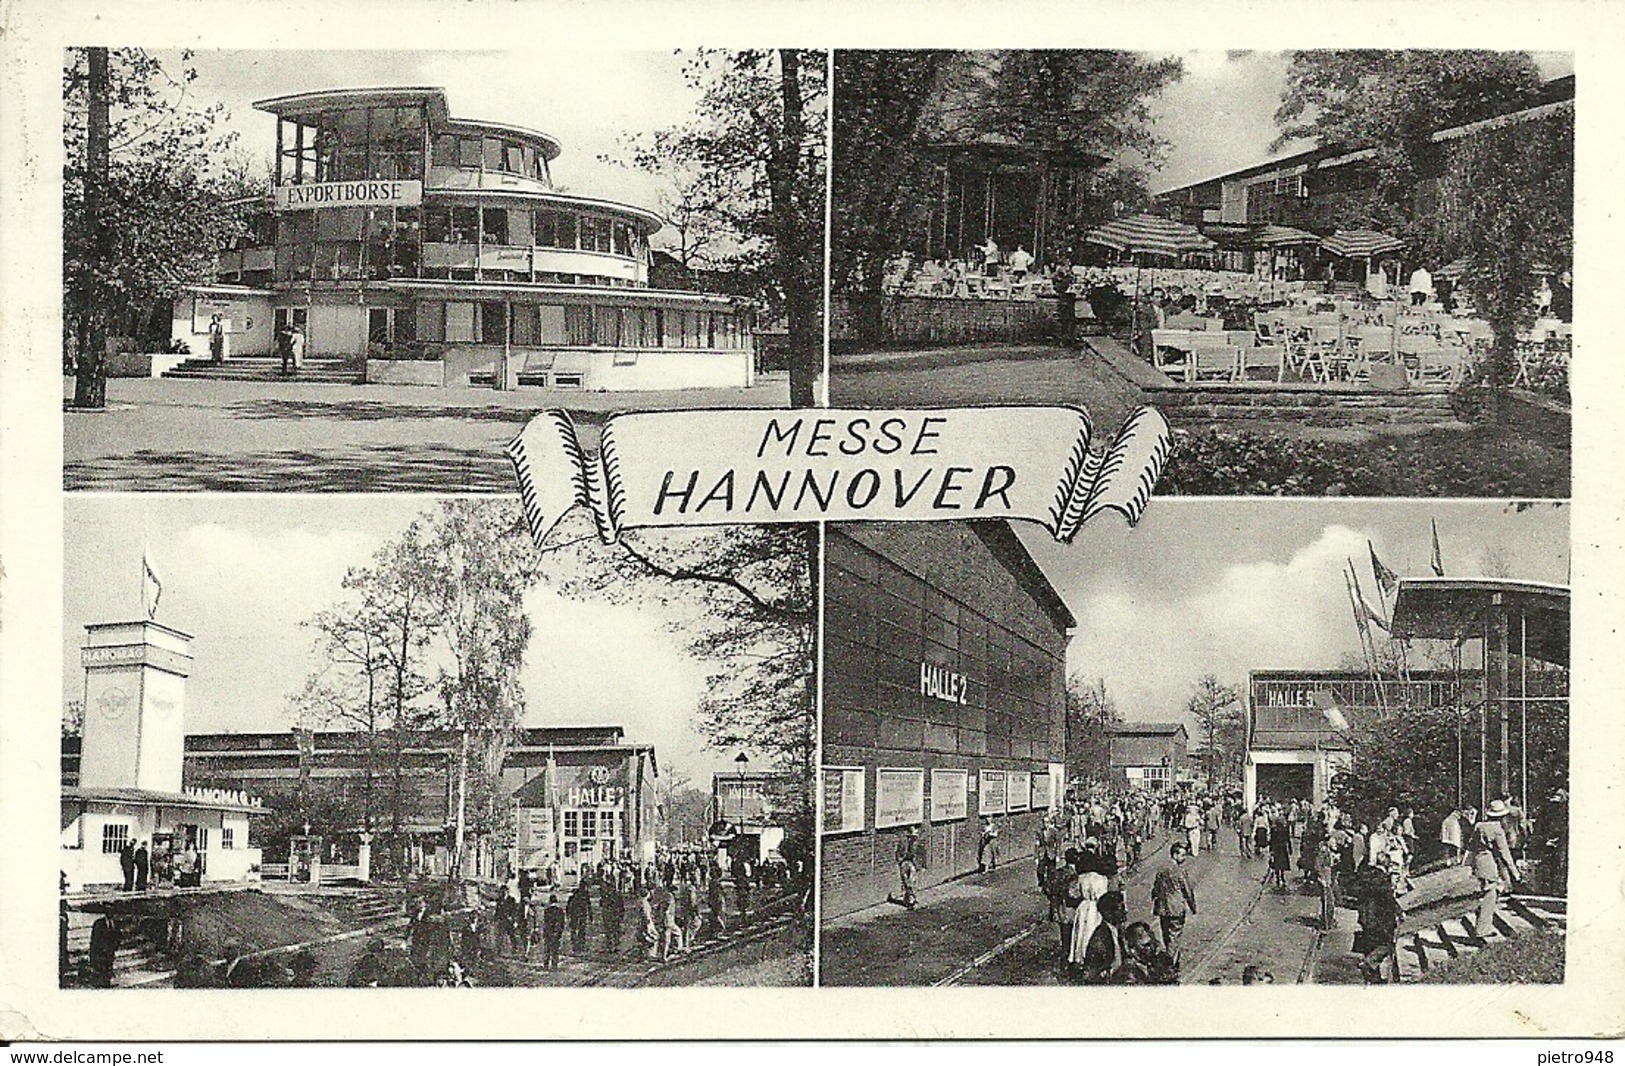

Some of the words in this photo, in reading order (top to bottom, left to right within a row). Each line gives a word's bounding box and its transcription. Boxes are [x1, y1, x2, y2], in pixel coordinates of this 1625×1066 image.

[757, 417, 948, 458] MESSE
[652, 464, 1017, 517] HANNOVER
[920, 662, 959, 702] HALLE
[959, 675, 967, 704] 2
[1268, 690, 1304, 708] HALLE
[568, 787, 616, 806] HALLE
